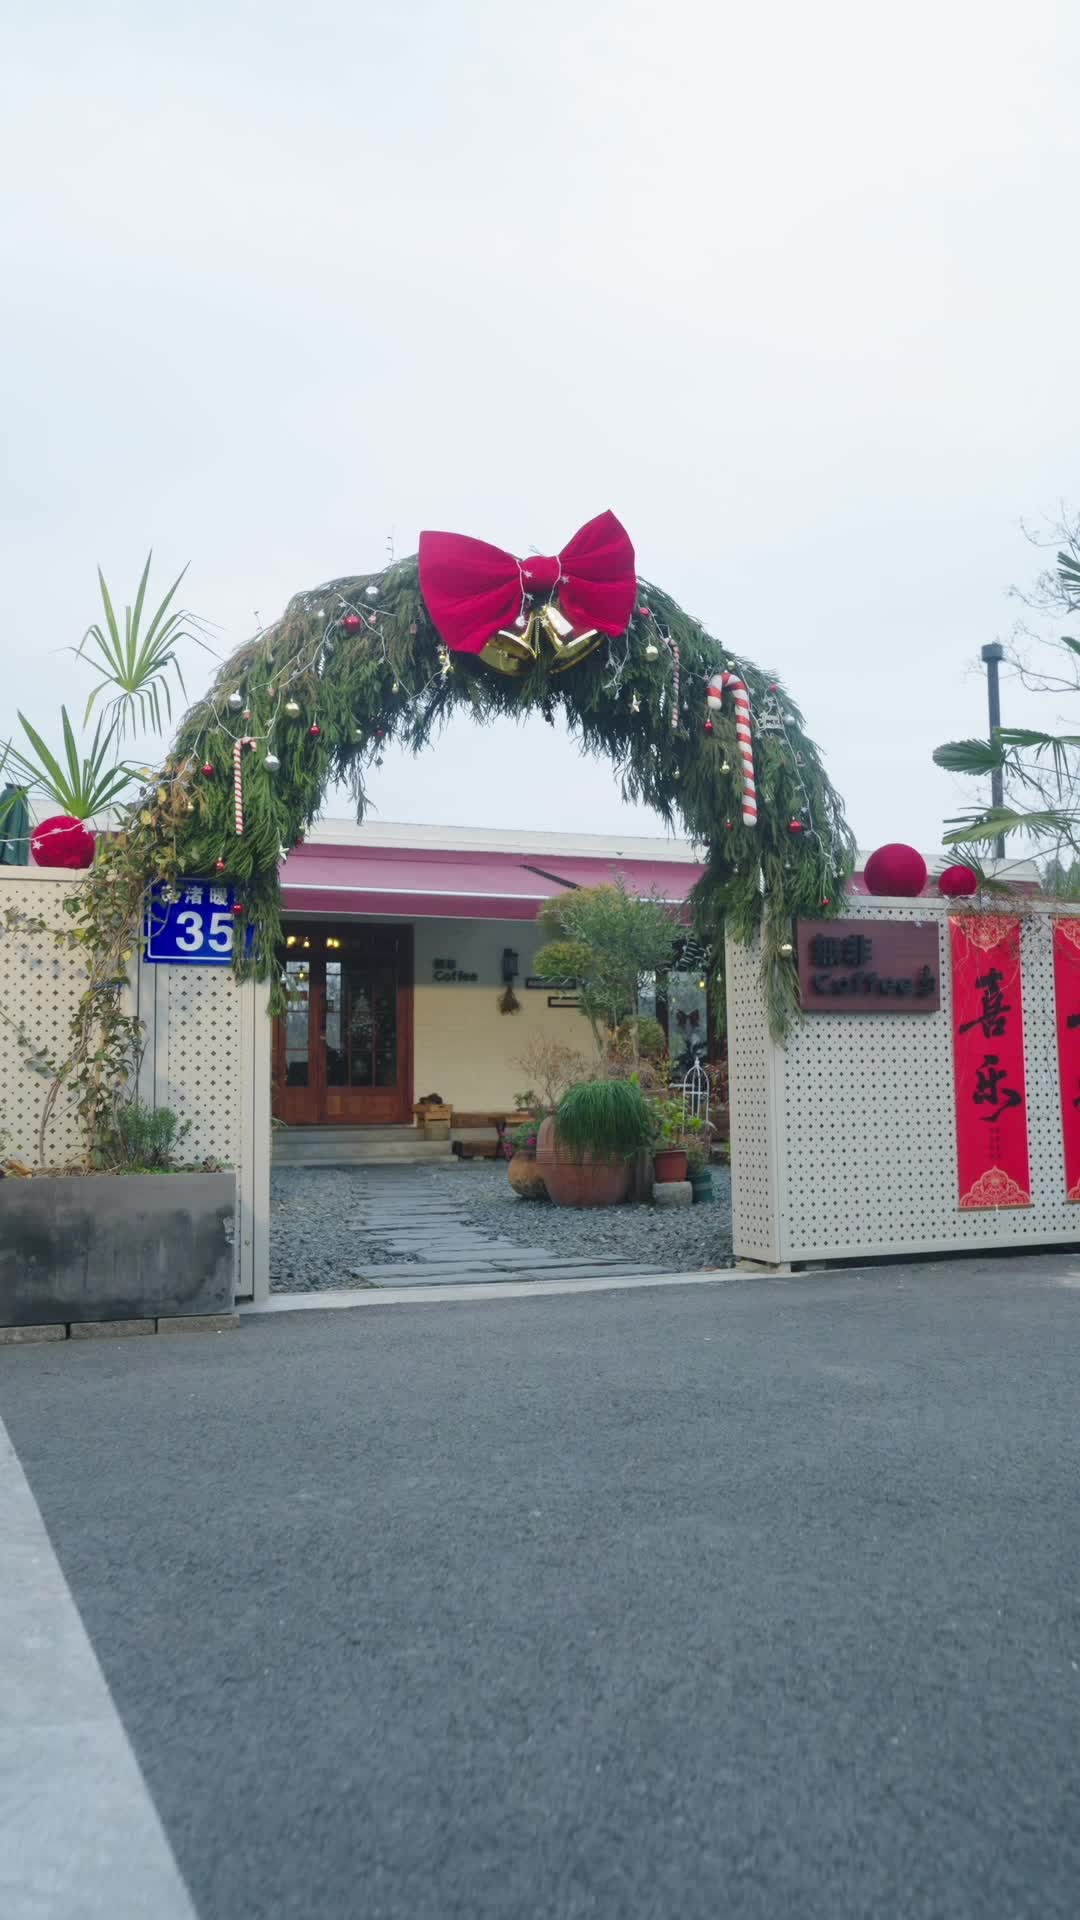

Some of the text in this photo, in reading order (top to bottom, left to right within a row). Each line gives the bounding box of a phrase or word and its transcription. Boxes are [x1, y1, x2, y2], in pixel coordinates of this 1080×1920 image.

[176, 911, 234, 952] 35
[433, 971, 478, 982] Coffee
[959, 968, 1022, 1122] 喜乐
